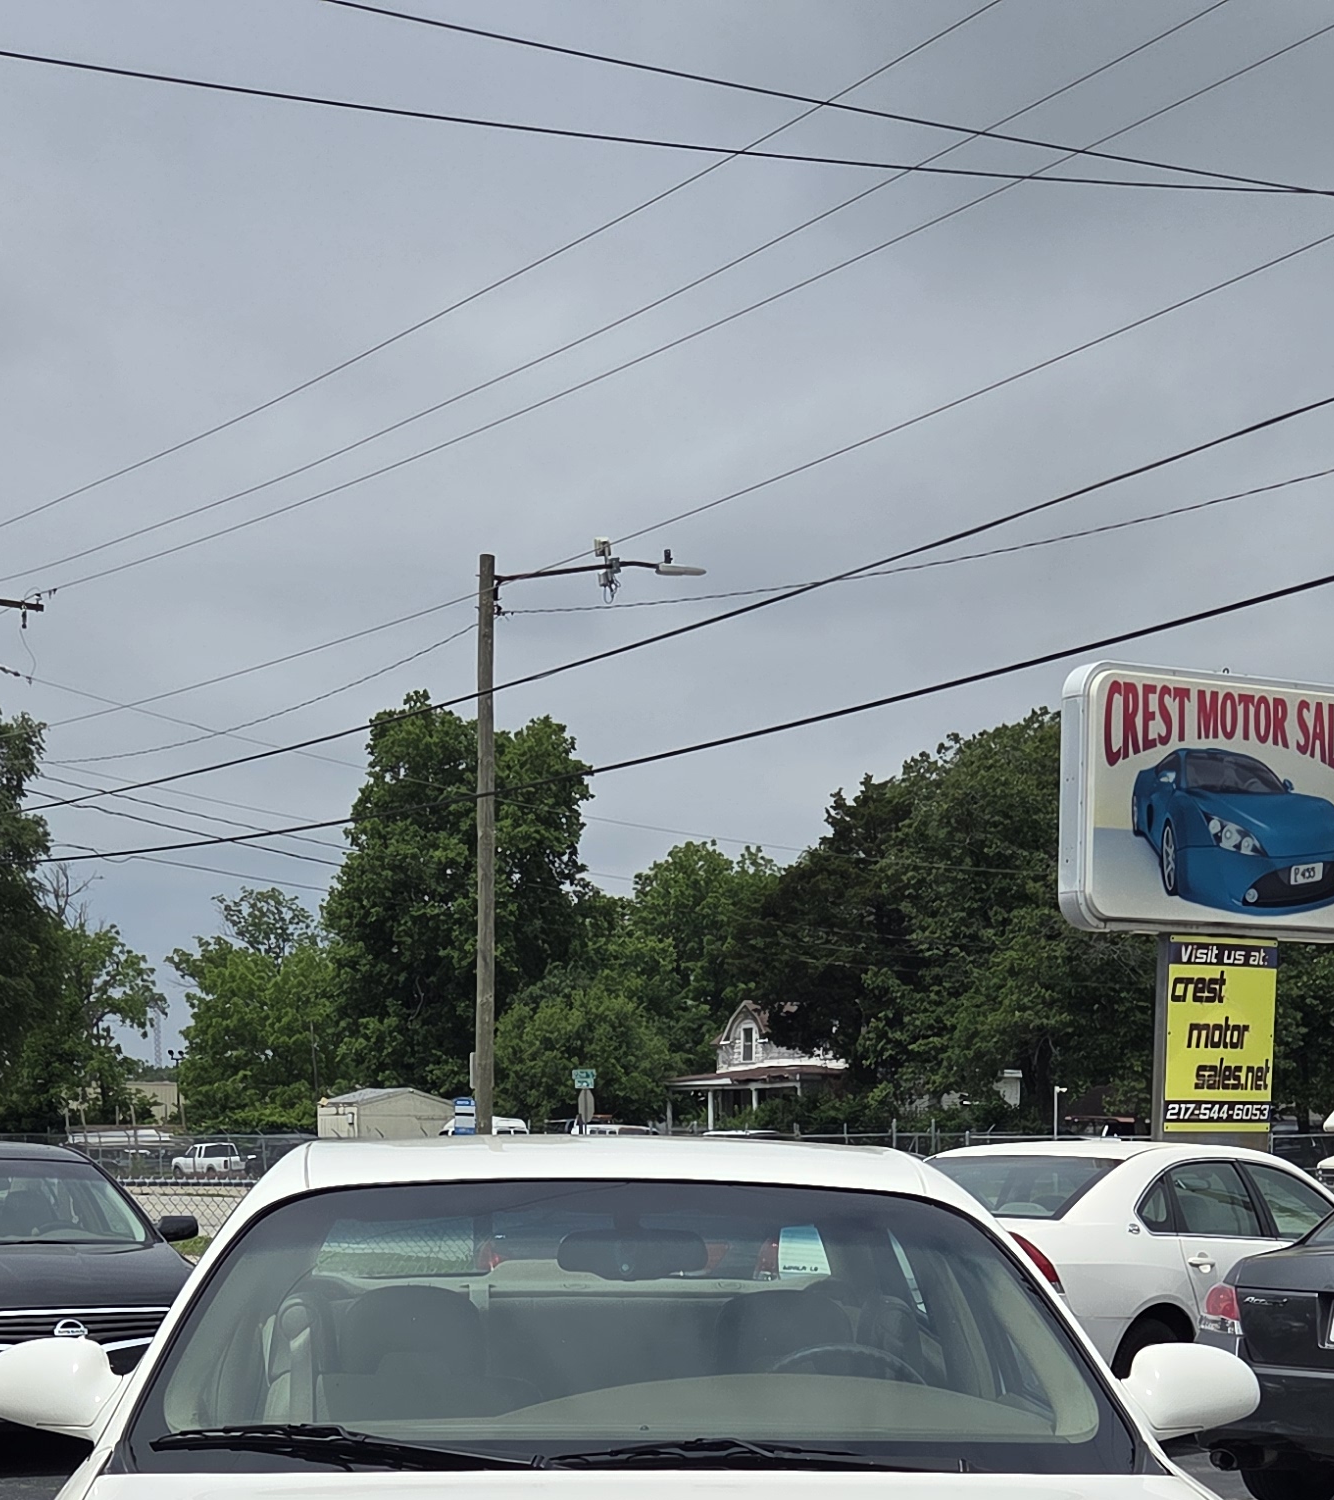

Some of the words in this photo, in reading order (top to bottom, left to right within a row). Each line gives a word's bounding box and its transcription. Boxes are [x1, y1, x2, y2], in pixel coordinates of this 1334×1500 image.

[1104, 680, 1191, 767] CREST
[1197, 689, 1289, 749] MOTOR
[1181, 945, 1218, 963] Visit
[1223, 950, 1245, 964] us
[1249, 948, 1269, 966] at:
[1170, 970, 1226, 1003] crest
[1186, 1016, 1250, 1049] motor
[1194, 1057, 1270, 1091] sales.net
[1166, 1103, 1270, 1120] 217-544-6053
